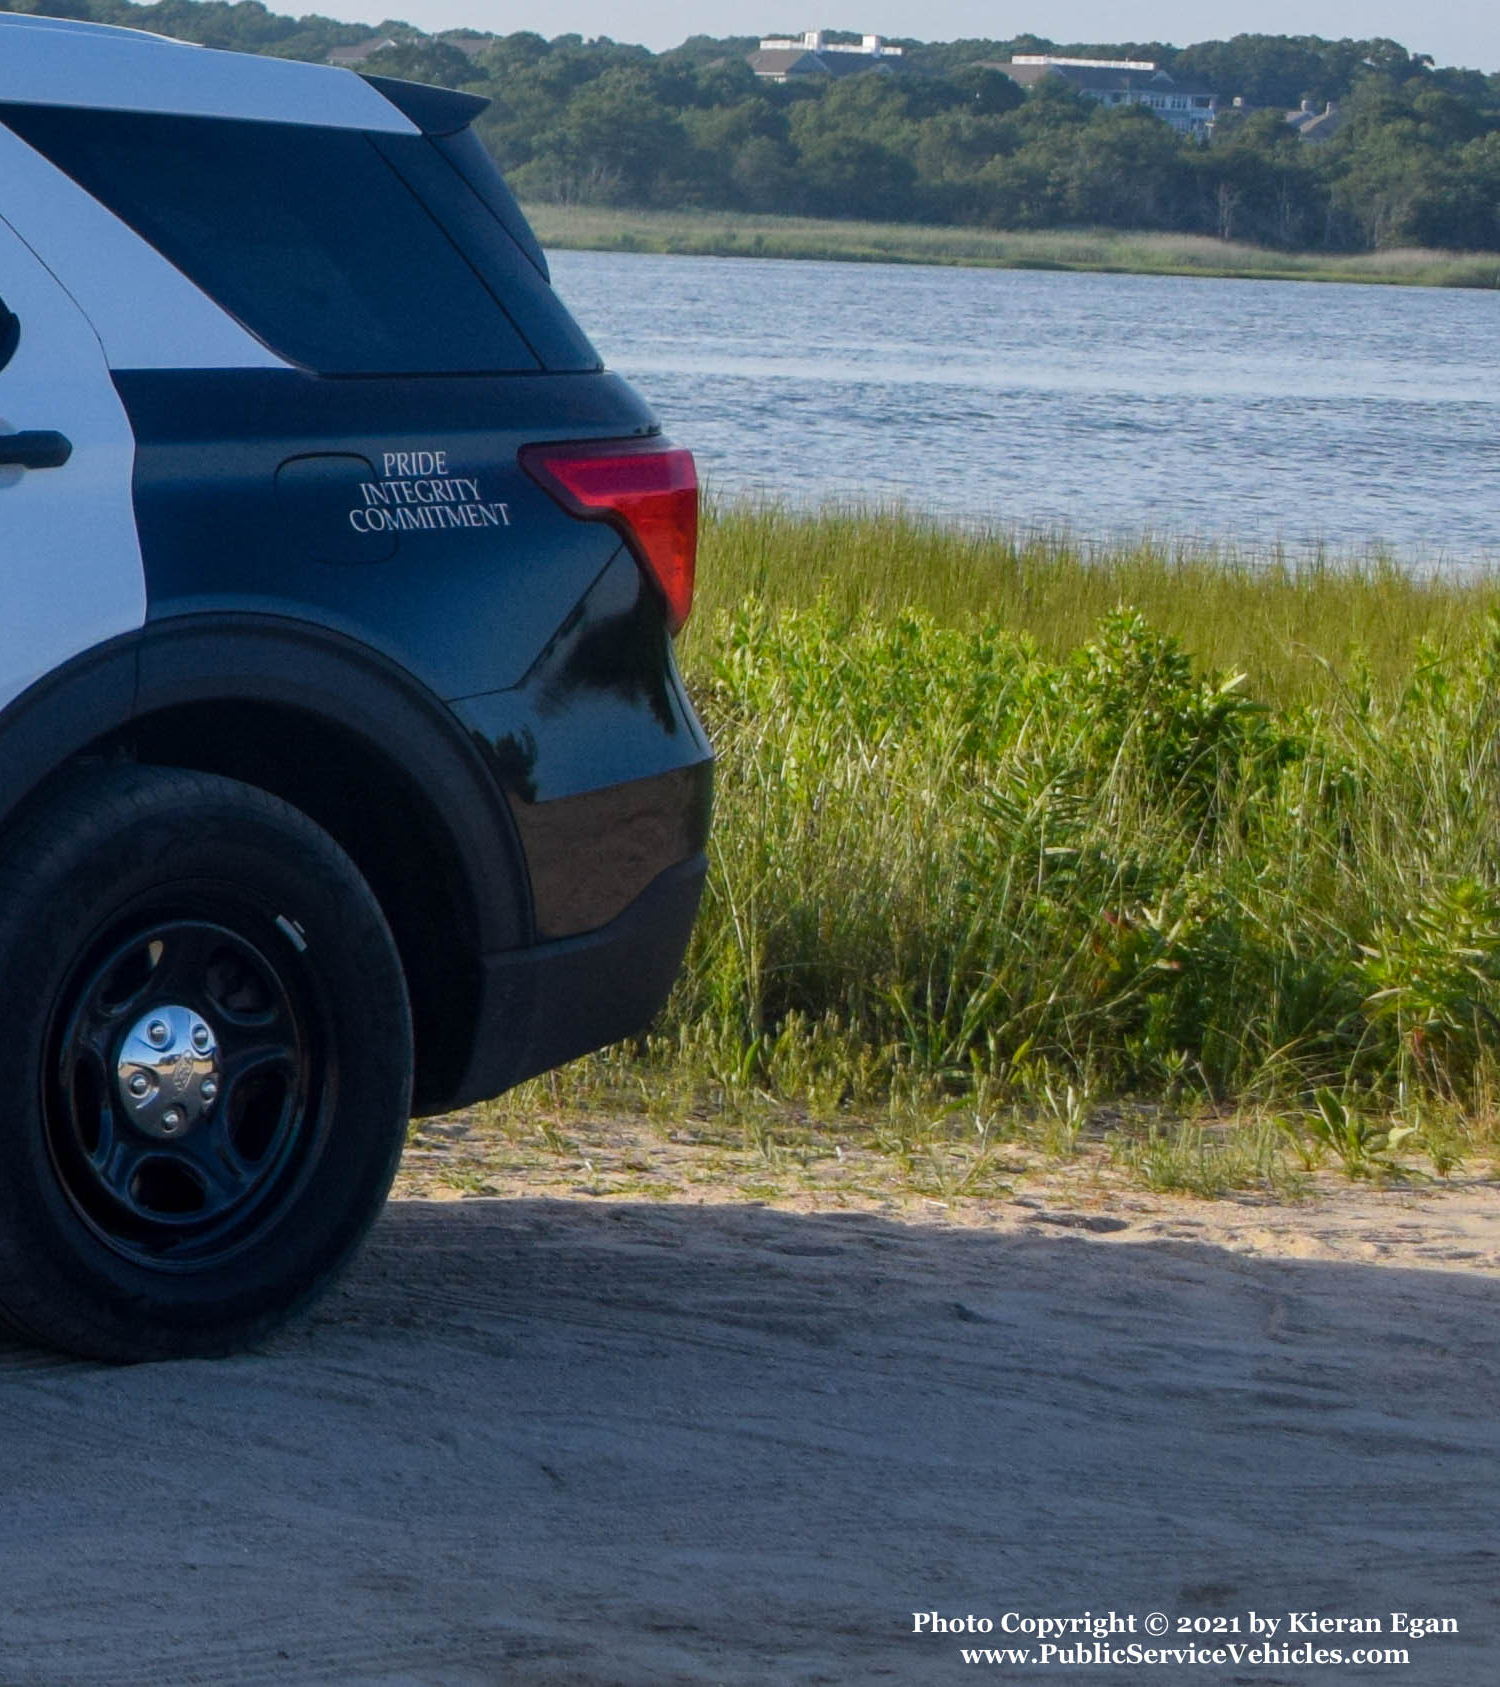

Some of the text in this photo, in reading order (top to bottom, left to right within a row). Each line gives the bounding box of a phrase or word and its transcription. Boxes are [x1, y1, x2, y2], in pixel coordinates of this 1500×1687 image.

[383, 451, 448, 476] PRIDE
[360, 478, 481, 505] INTEGRITY
[349, 503, 512, 533] COMMITMENT
